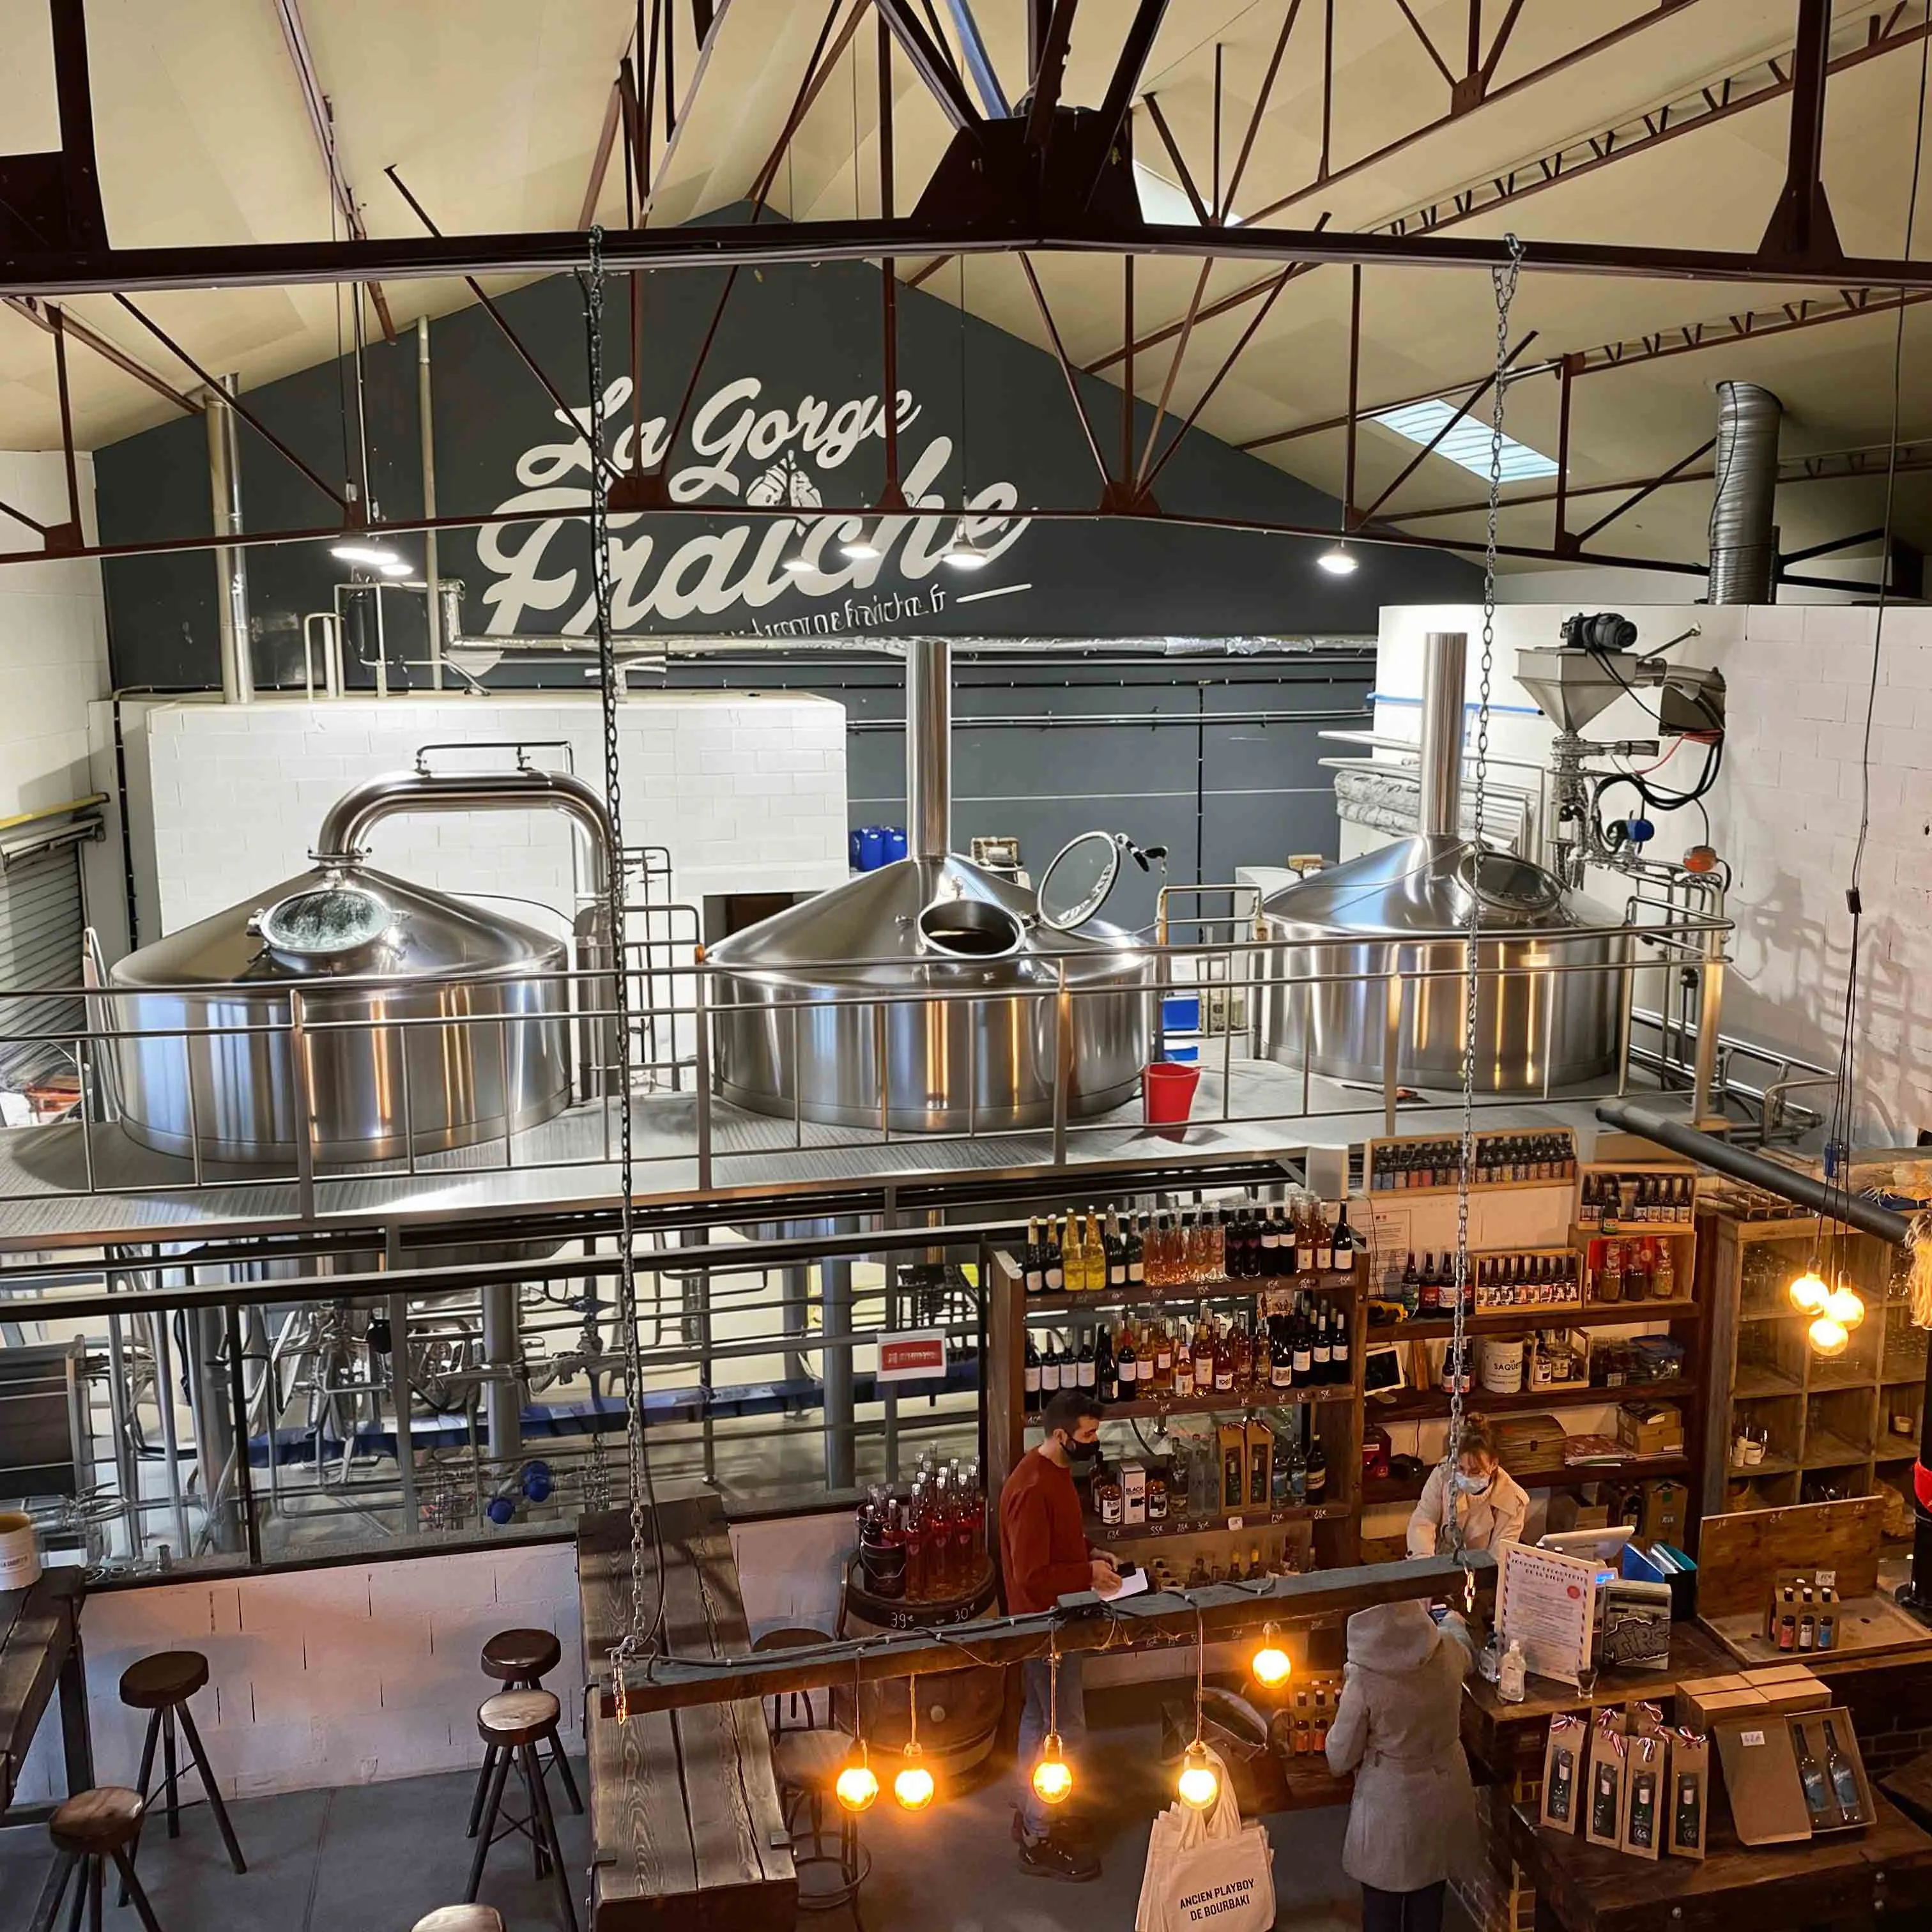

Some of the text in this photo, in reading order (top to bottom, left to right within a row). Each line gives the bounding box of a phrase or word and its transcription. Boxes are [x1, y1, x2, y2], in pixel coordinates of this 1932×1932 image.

[516, 376, 922, 502] La Gorge
[1606, 1623, 1669, 1660] TIPS
[1180, 1878, 1254, 1910] ANCIEN PLAYBOY
[1190, 1894, 1250, 1921] DE BOURBAKI
